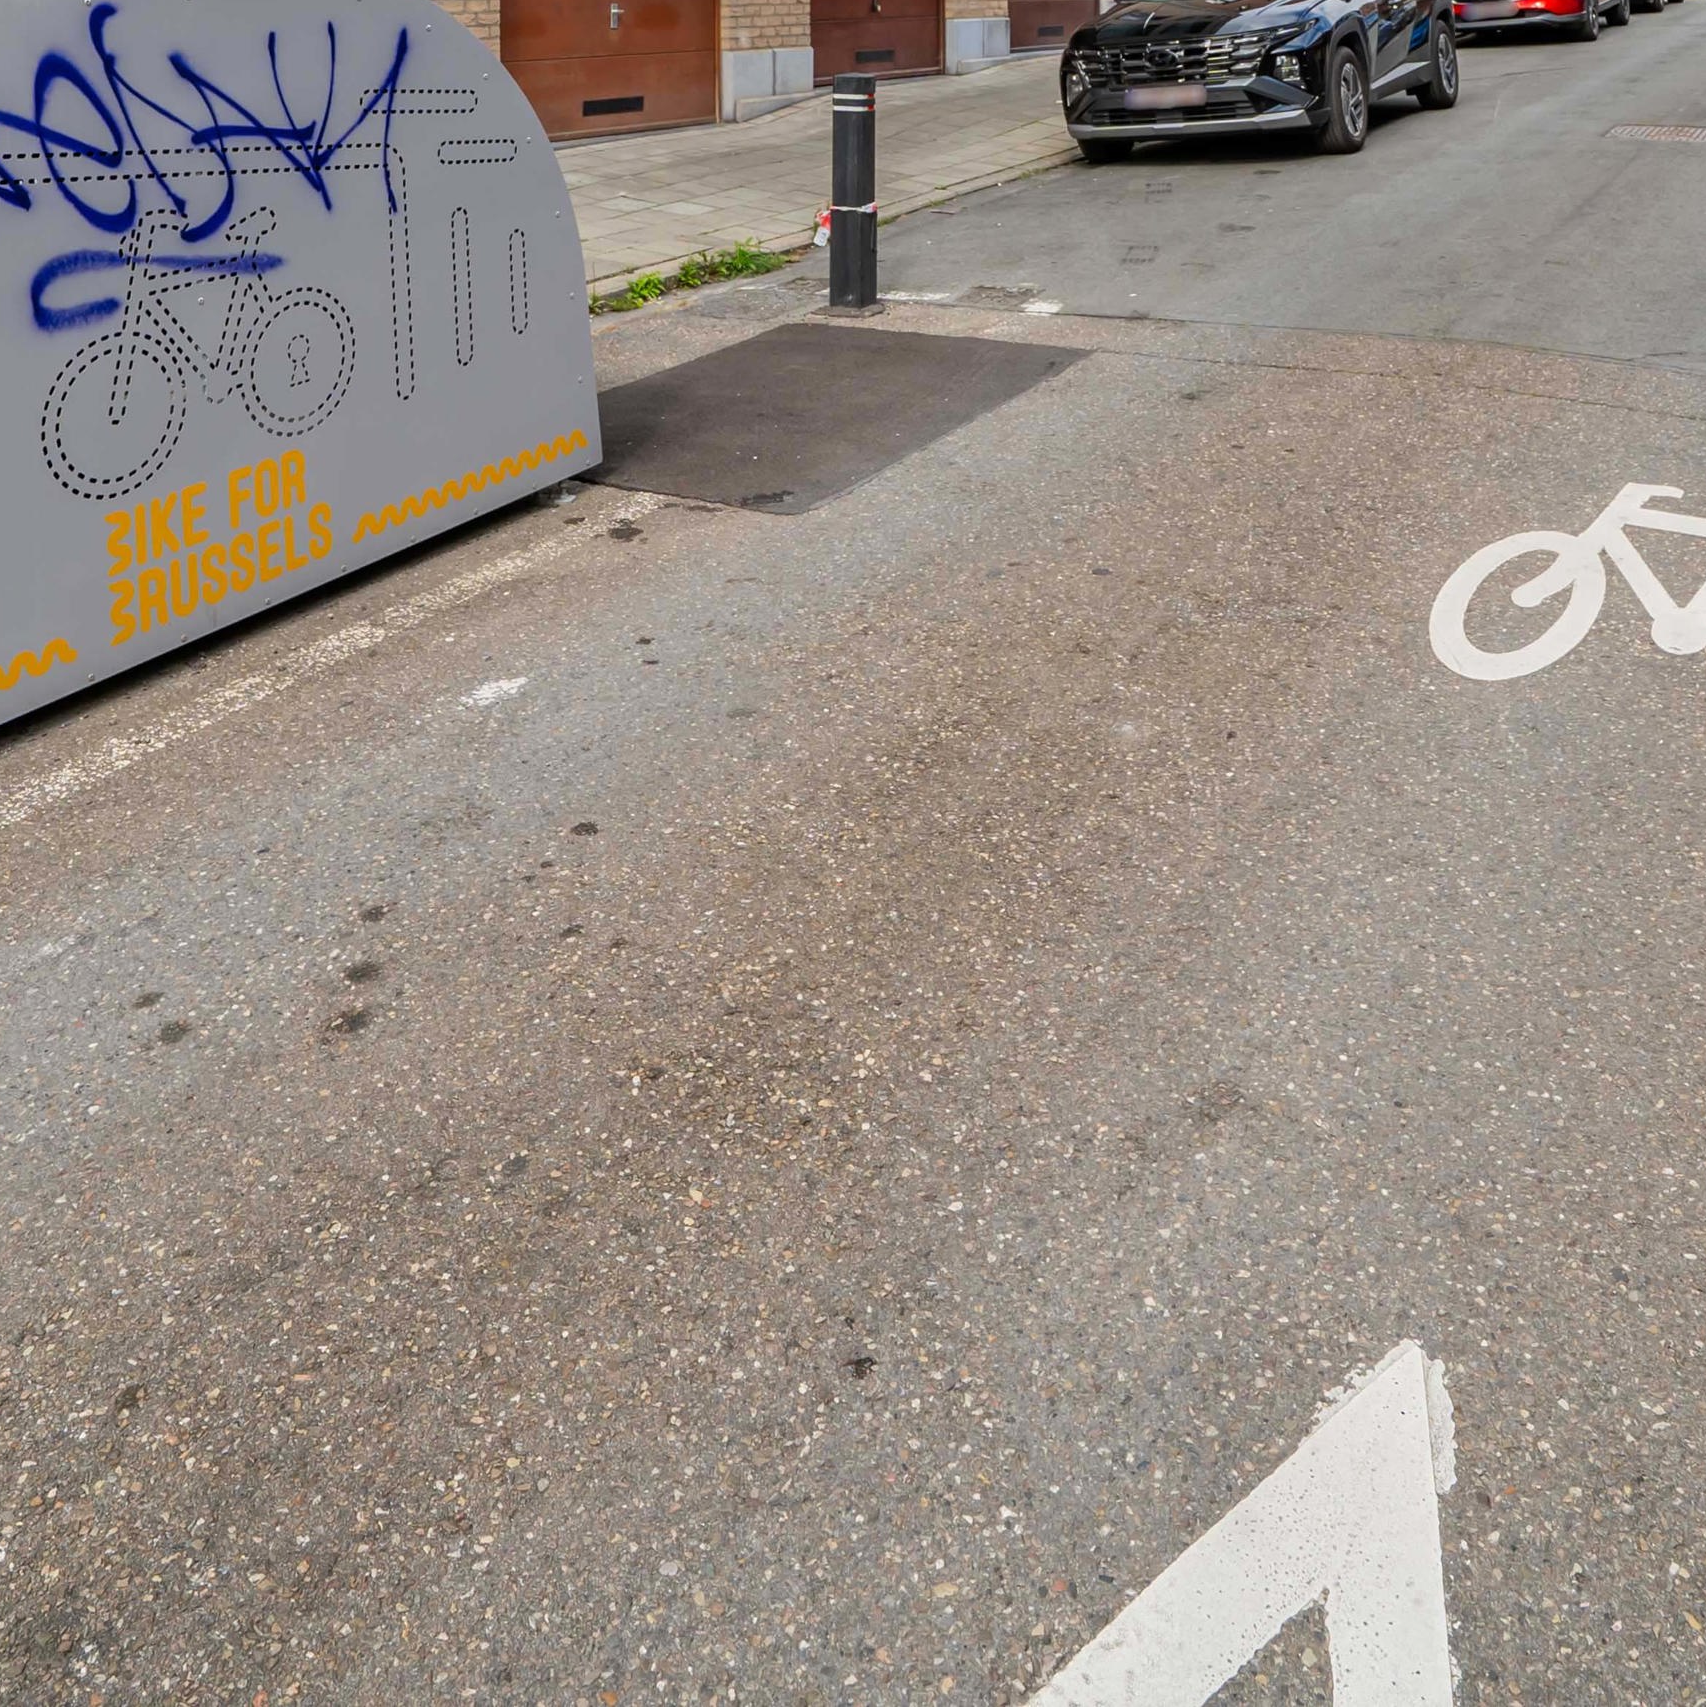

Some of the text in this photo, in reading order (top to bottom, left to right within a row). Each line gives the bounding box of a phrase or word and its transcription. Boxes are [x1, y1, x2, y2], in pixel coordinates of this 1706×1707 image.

[104, 448, 306, 577] BIKE FOR
[108, 502, 333, 647] BRUSSELS
